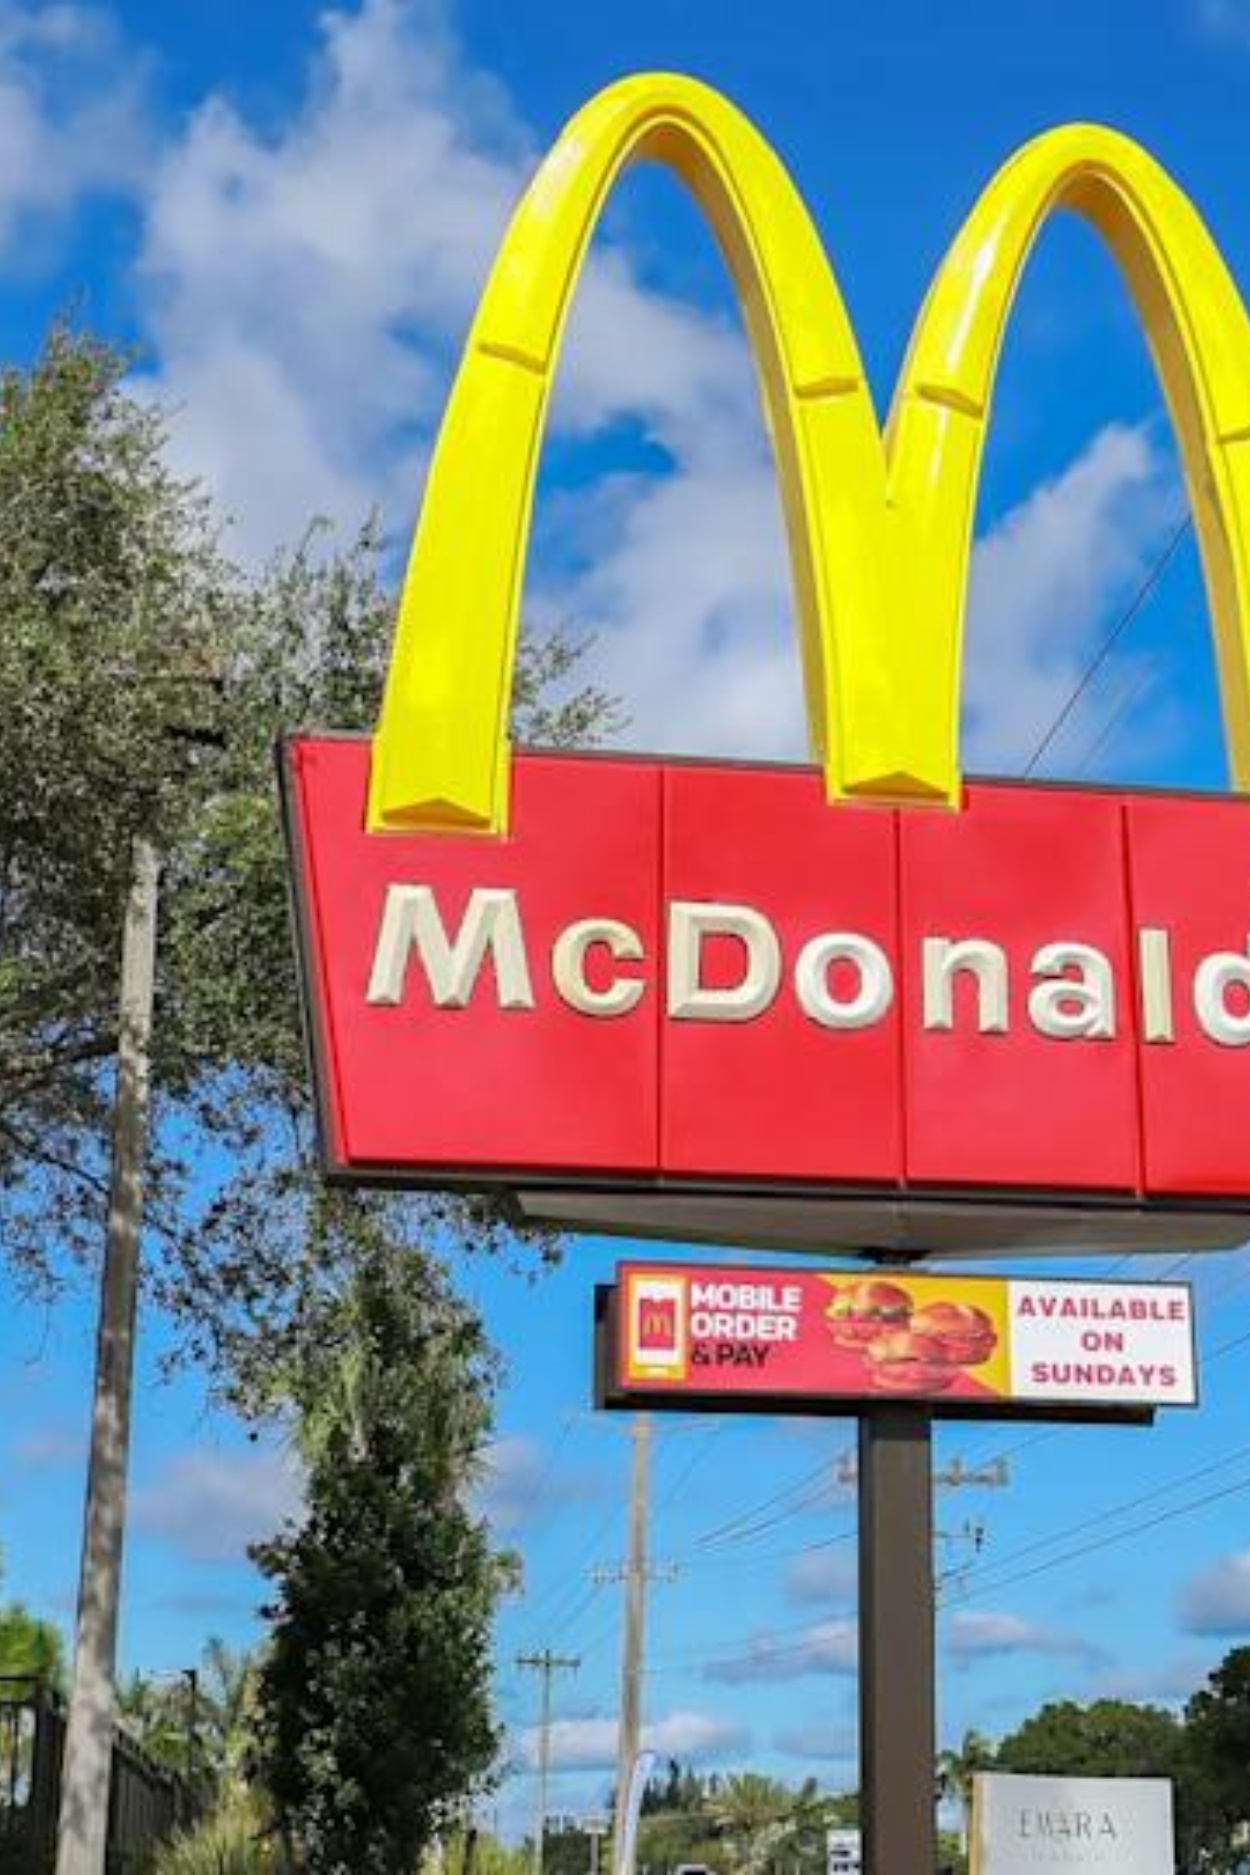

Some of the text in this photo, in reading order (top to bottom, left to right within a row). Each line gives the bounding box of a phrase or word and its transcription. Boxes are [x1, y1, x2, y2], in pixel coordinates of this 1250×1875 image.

[690, 1284, 802, 1312] MOBILE
[1018, 1295, 1186, 1321] AVAILABLE
[690, 1313, 797, 1341] ORDER
[1081, 1331, 1124, 1352] ON
[691, 1345, 770, 1368] & PAY
[1031, 1363, 1176, 1387] SUNDAYS
